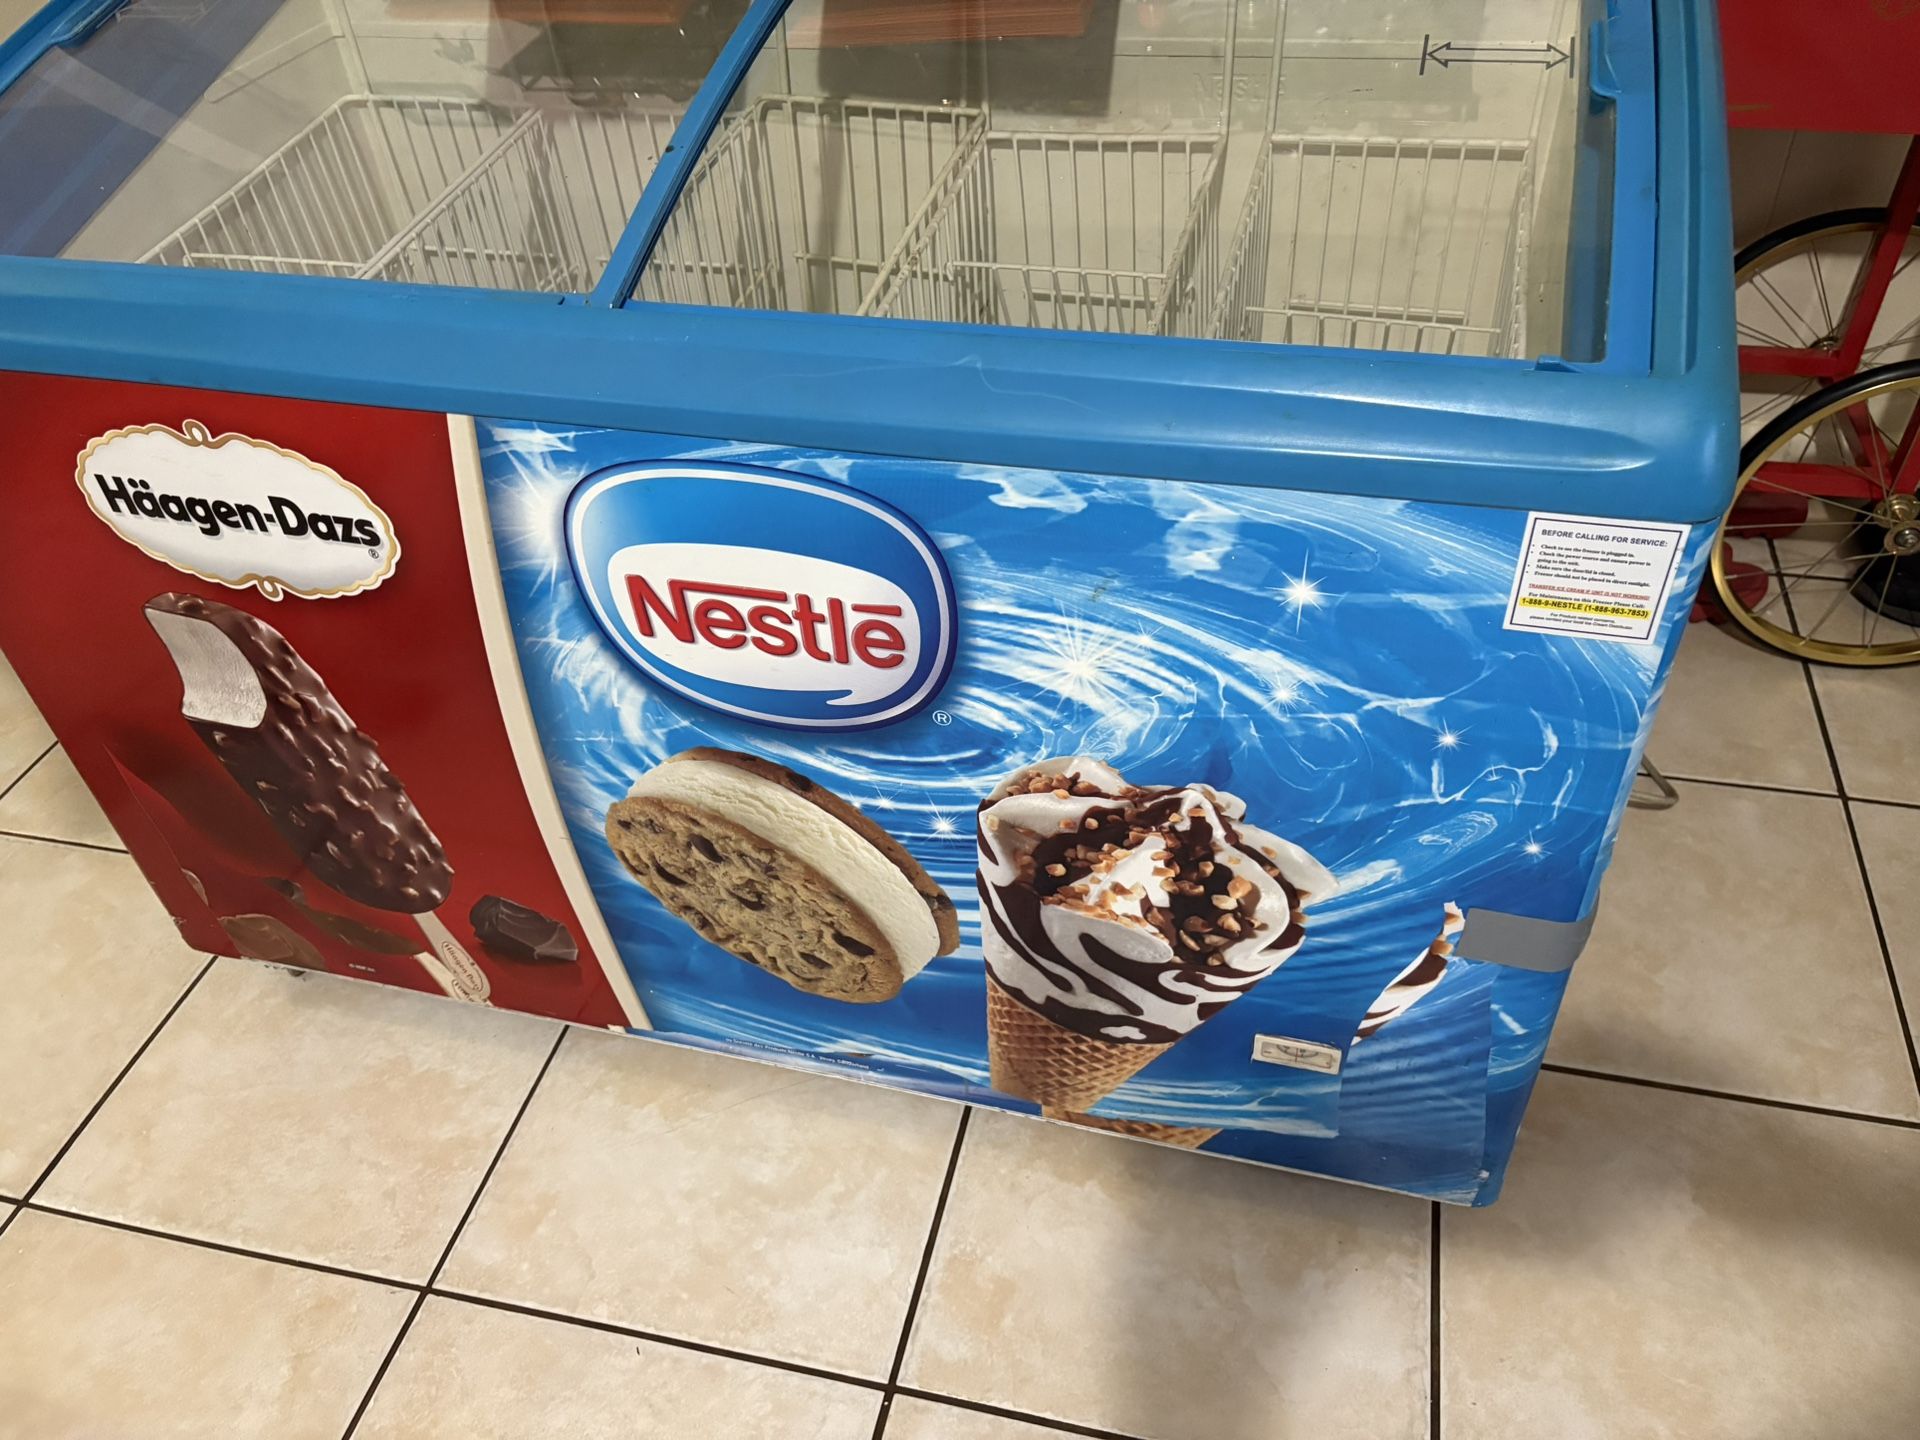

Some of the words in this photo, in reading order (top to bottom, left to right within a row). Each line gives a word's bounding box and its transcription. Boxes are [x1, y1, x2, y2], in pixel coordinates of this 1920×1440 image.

[93, 473, 381, 547] Häagen-Dazs
[1541, 529, 1574, 539] BEFORE
[1575, 532, 1609, 542] CALLING
[1611, 535, 1628, 544] FOR
[1630, 537, 1668, 547] SERVICE:
[1522, 597, 1583, 610] 1-888-9-NESTLE
